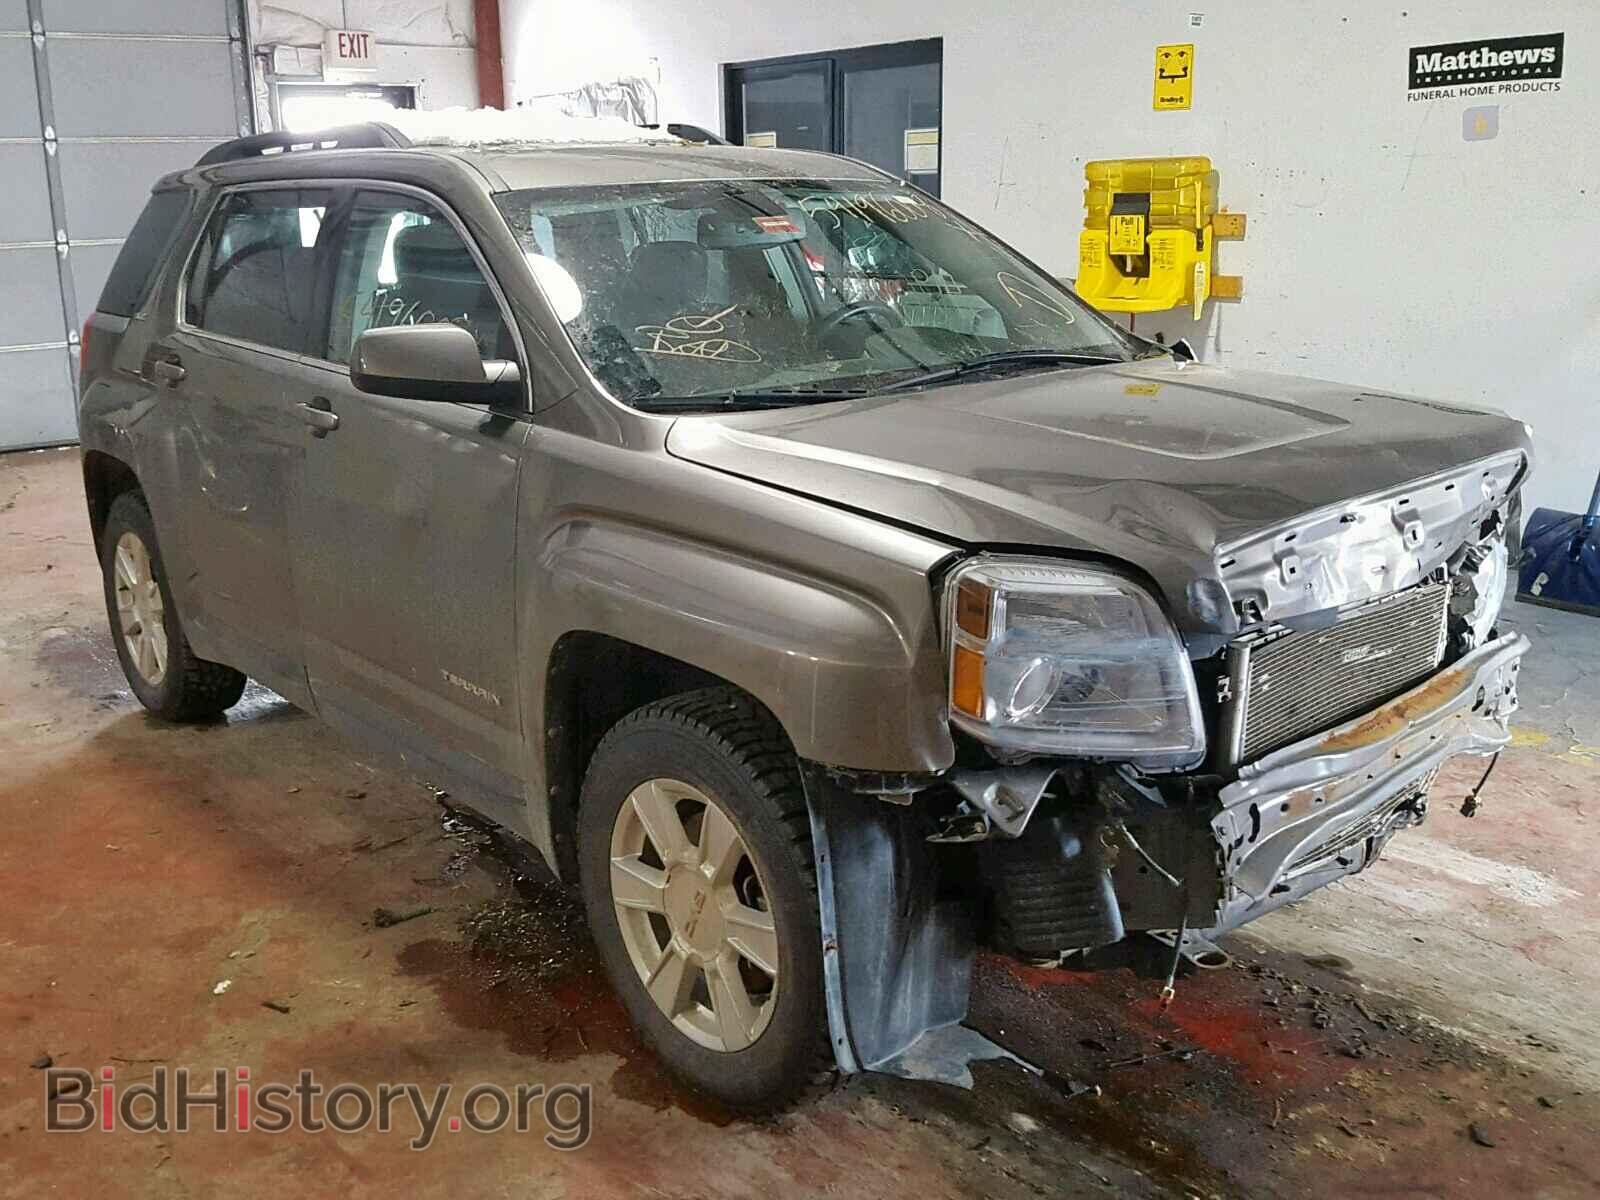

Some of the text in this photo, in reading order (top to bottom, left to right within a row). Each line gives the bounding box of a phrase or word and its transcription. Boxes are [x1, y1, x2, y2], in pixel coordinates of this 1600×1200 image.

[338, 33, 369, 58] EXIT
[1415, 46, 1556, 74] Matthews
[1407, 82, 1561, 102] FUNERAL HOME PRODUCTS
[1120, 216, 1134, 225] Pull
